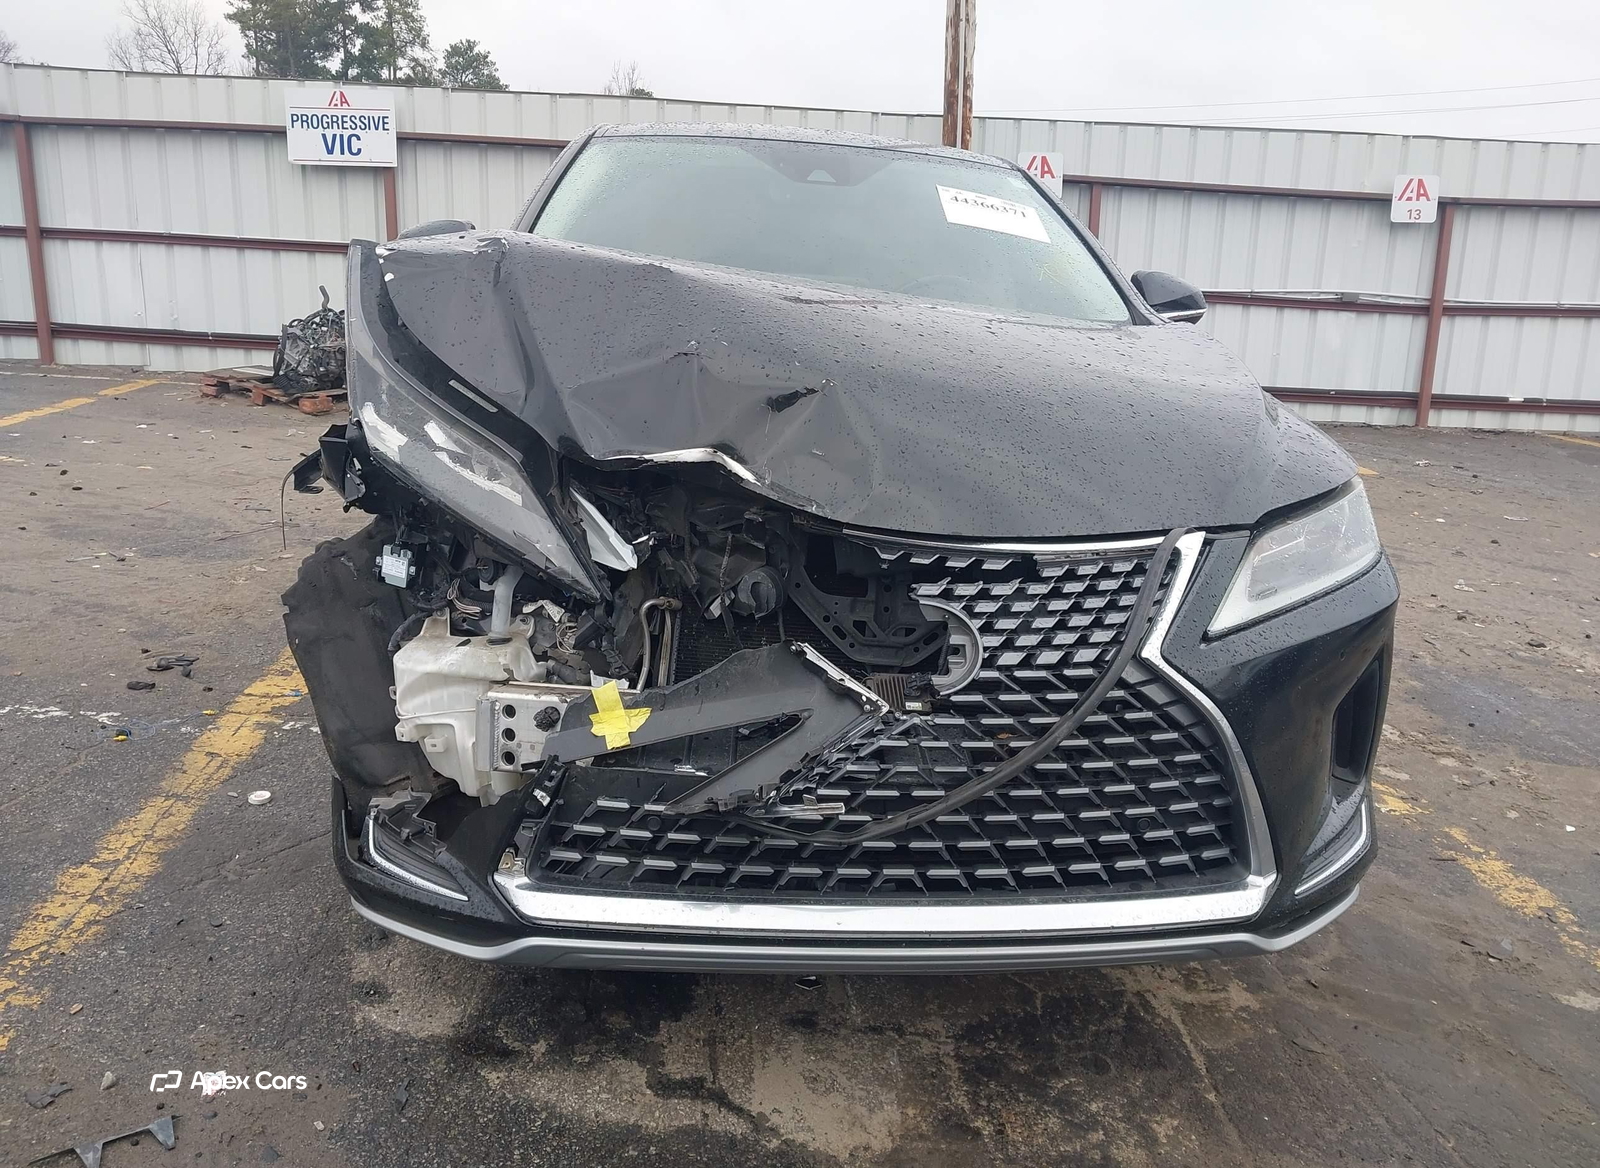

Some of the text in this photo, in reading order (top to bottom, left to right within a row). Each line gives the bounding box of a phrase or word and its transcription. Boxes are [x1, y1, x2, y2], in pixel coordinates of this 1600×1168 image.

[290, 113, 390, 131] PROGRESSIVE
[321, 133, 362, 156] VIC
[950, 195, 1026, 218] 44366371
[1407, 209, 1422, 220] 13
